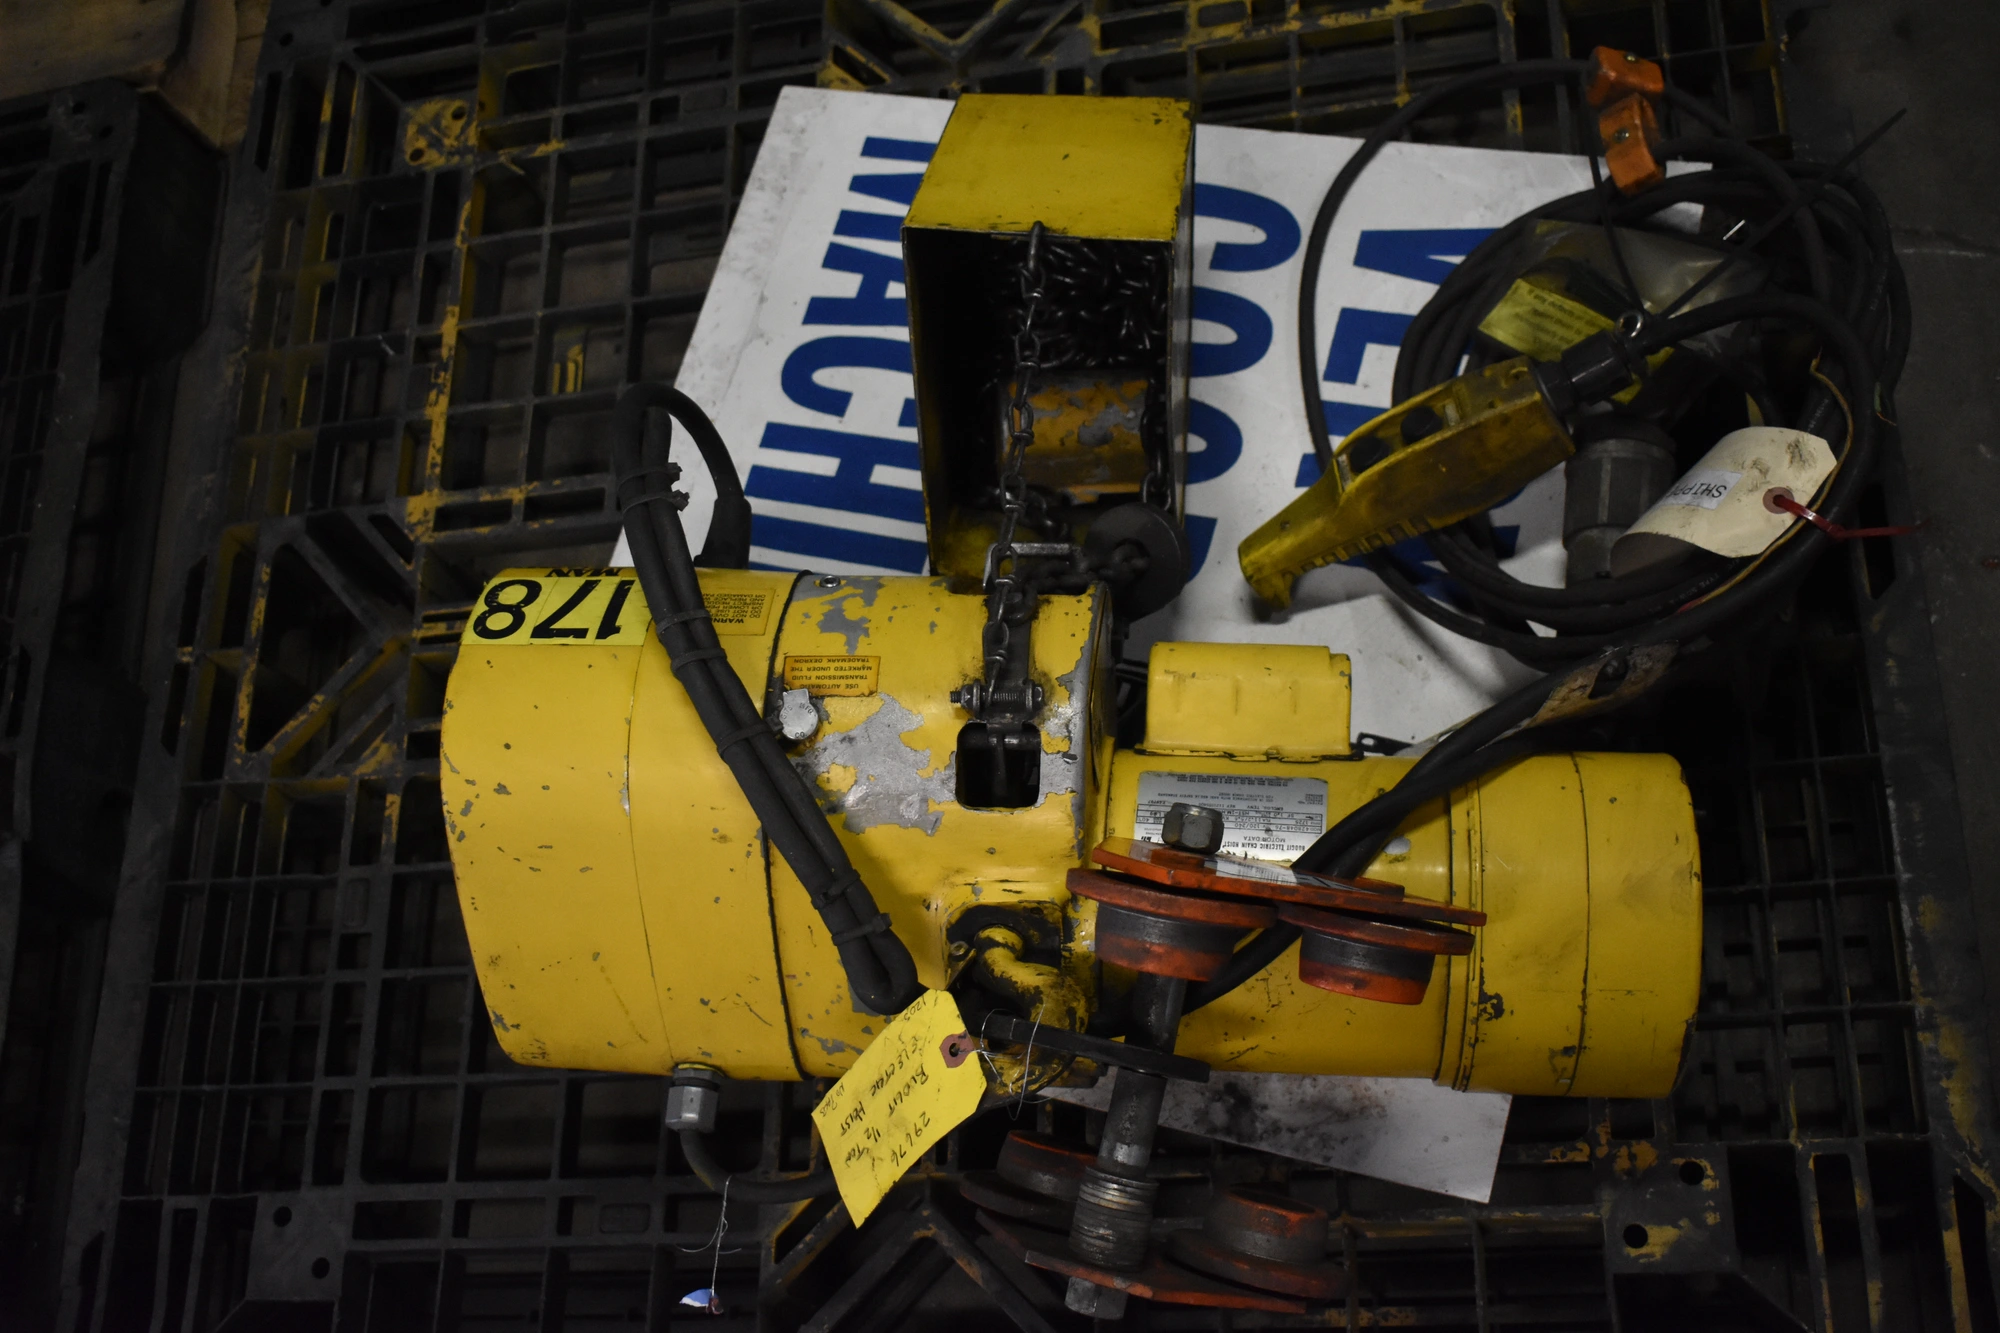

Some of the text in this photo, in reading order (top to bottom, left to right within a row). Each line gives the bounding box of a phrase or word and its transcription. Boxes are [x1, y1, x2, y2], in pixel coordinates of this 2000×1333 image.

[473, 579, 636, 640] 178
[1241, 842, 1258, 850] CHAIN
[1259, 843, 1285, 852] ELECTRIC
[890, 1110, 930, 1167] 29676
